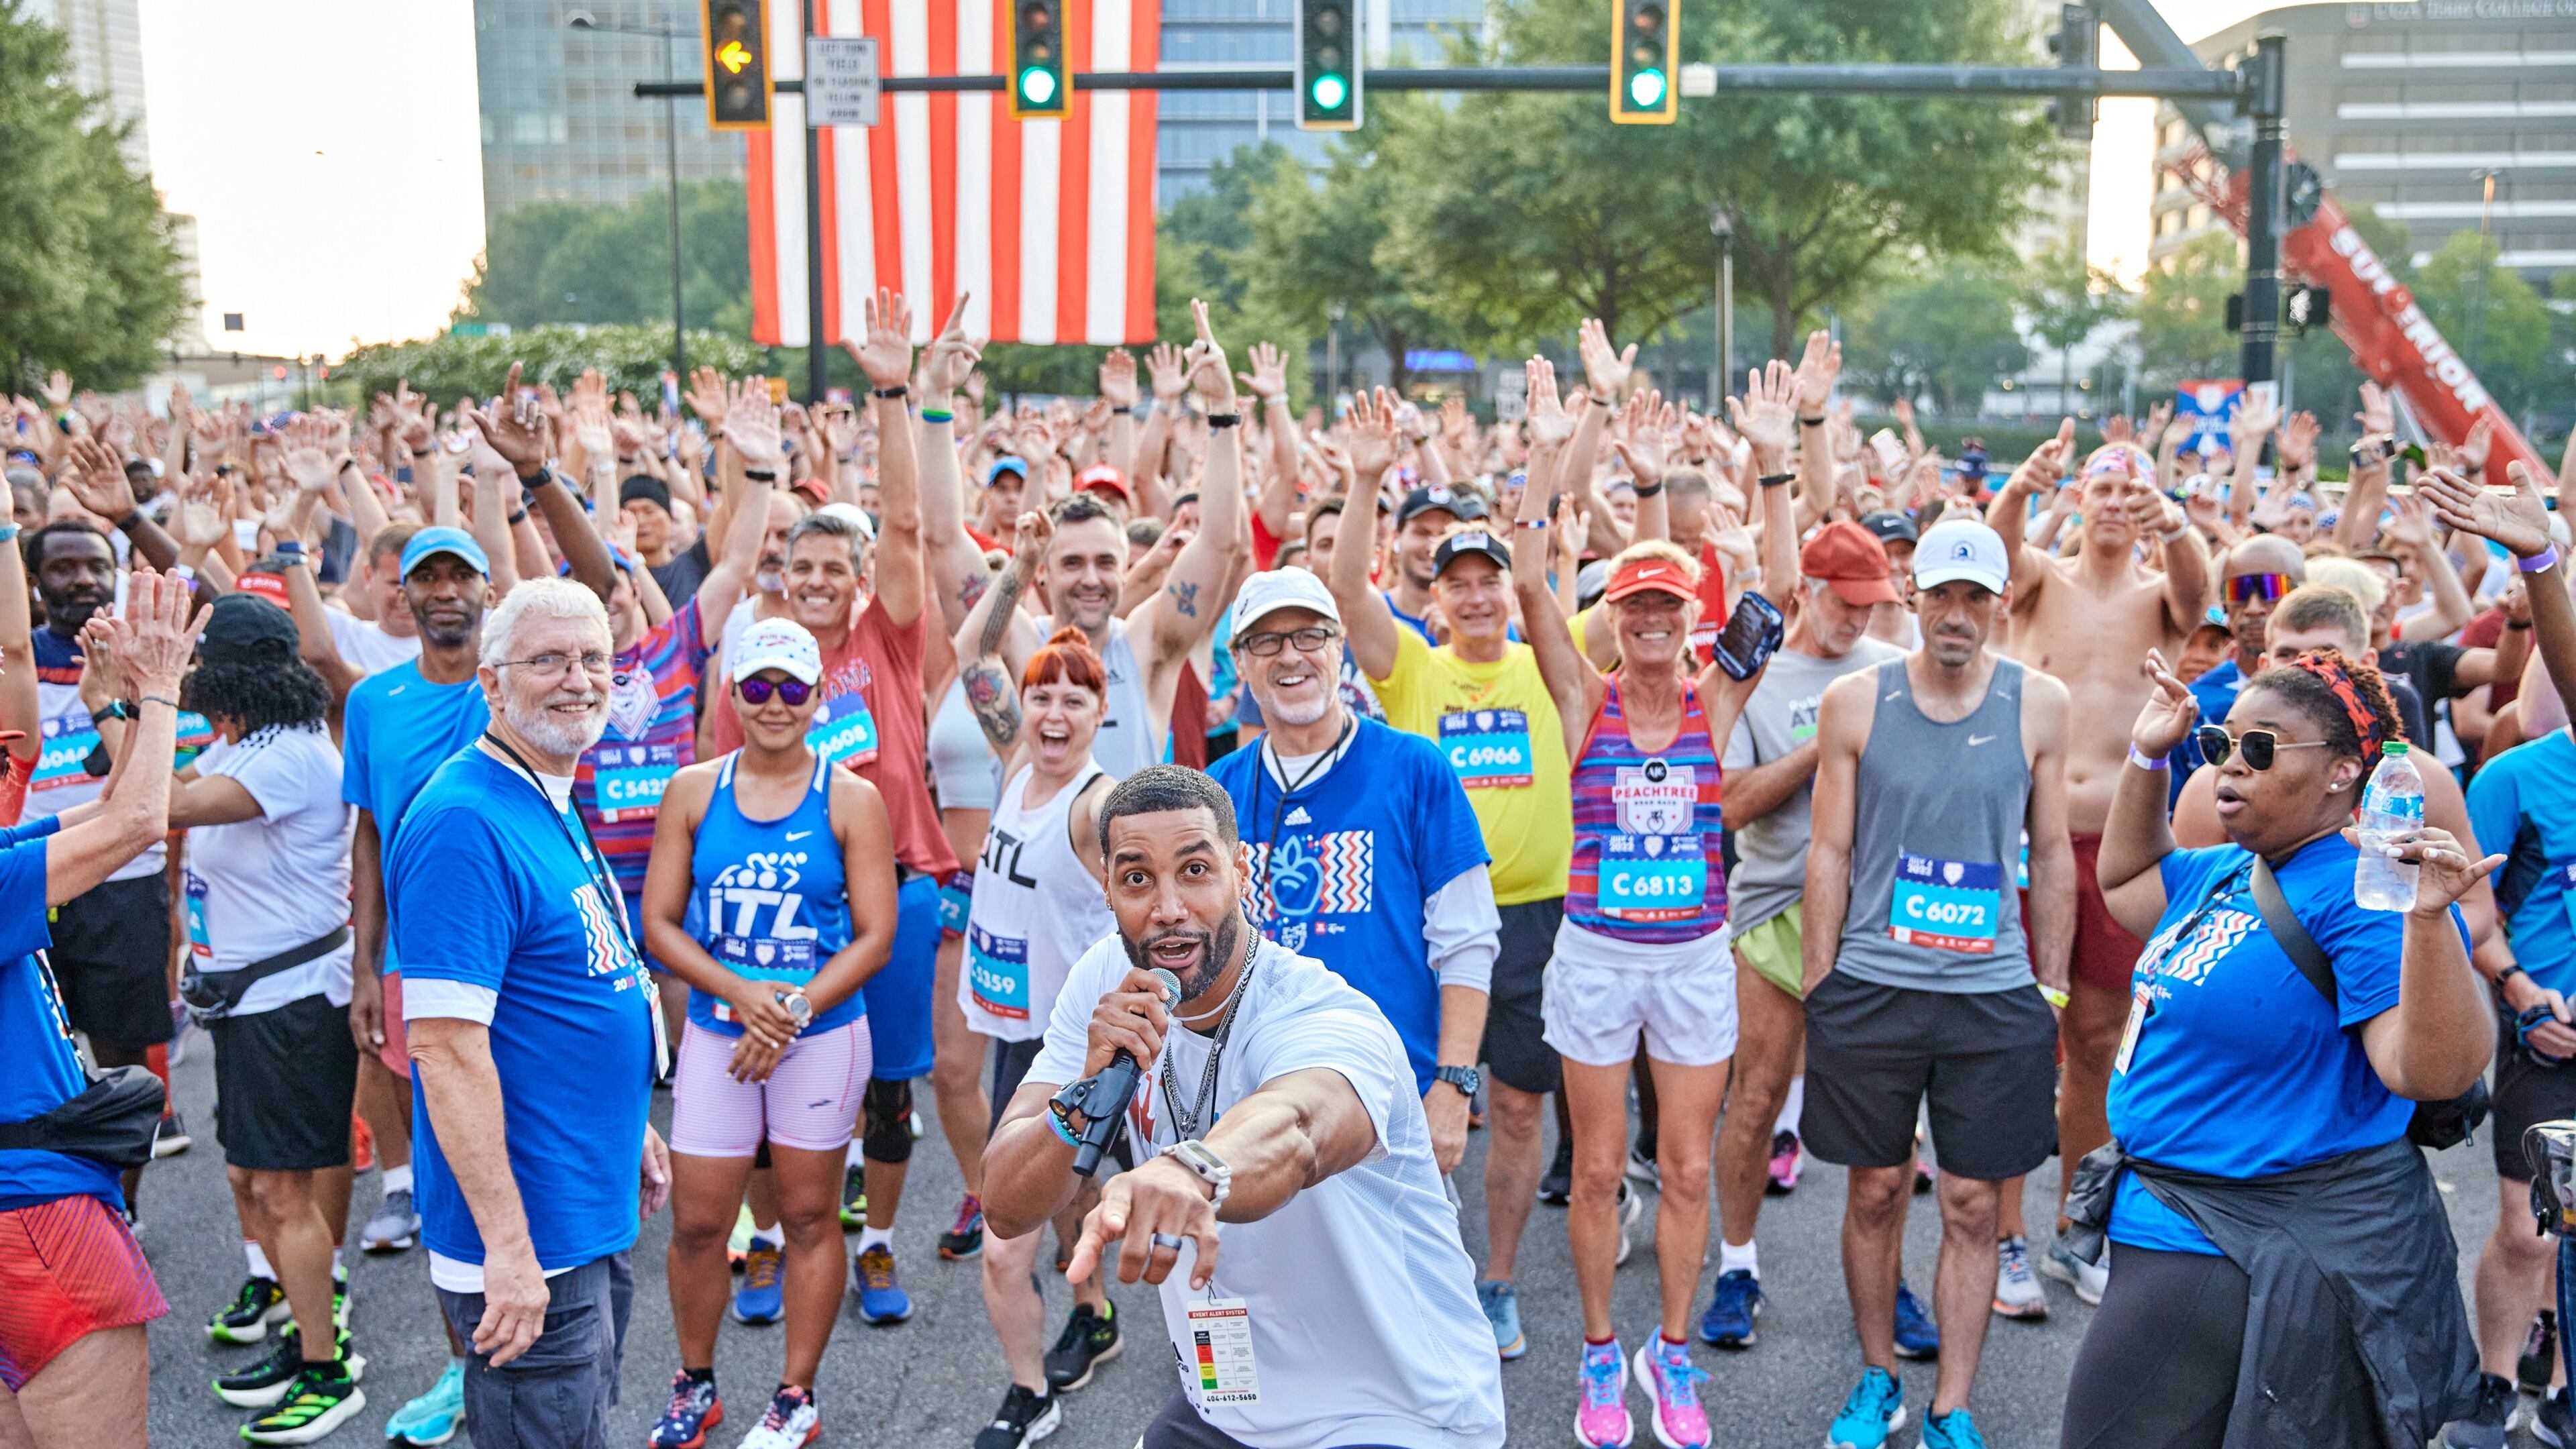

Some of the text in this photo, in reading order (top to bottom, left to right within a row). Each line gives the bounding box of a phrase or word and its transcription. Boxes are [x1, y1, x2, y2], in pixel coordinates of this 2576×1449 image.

[1450, 746, 1521, 767] C 6966
[606, 779, 623, 800] C
[1615, 786, 1695, 799] PEACHTREE
[1612, 872, 1693, 896] C 6813
[1905, 894, 1986, 925] C 6072
[977, 969, 1016, 995] 5359
[1207, 1393, 1256, 1402] 404-612-5650
